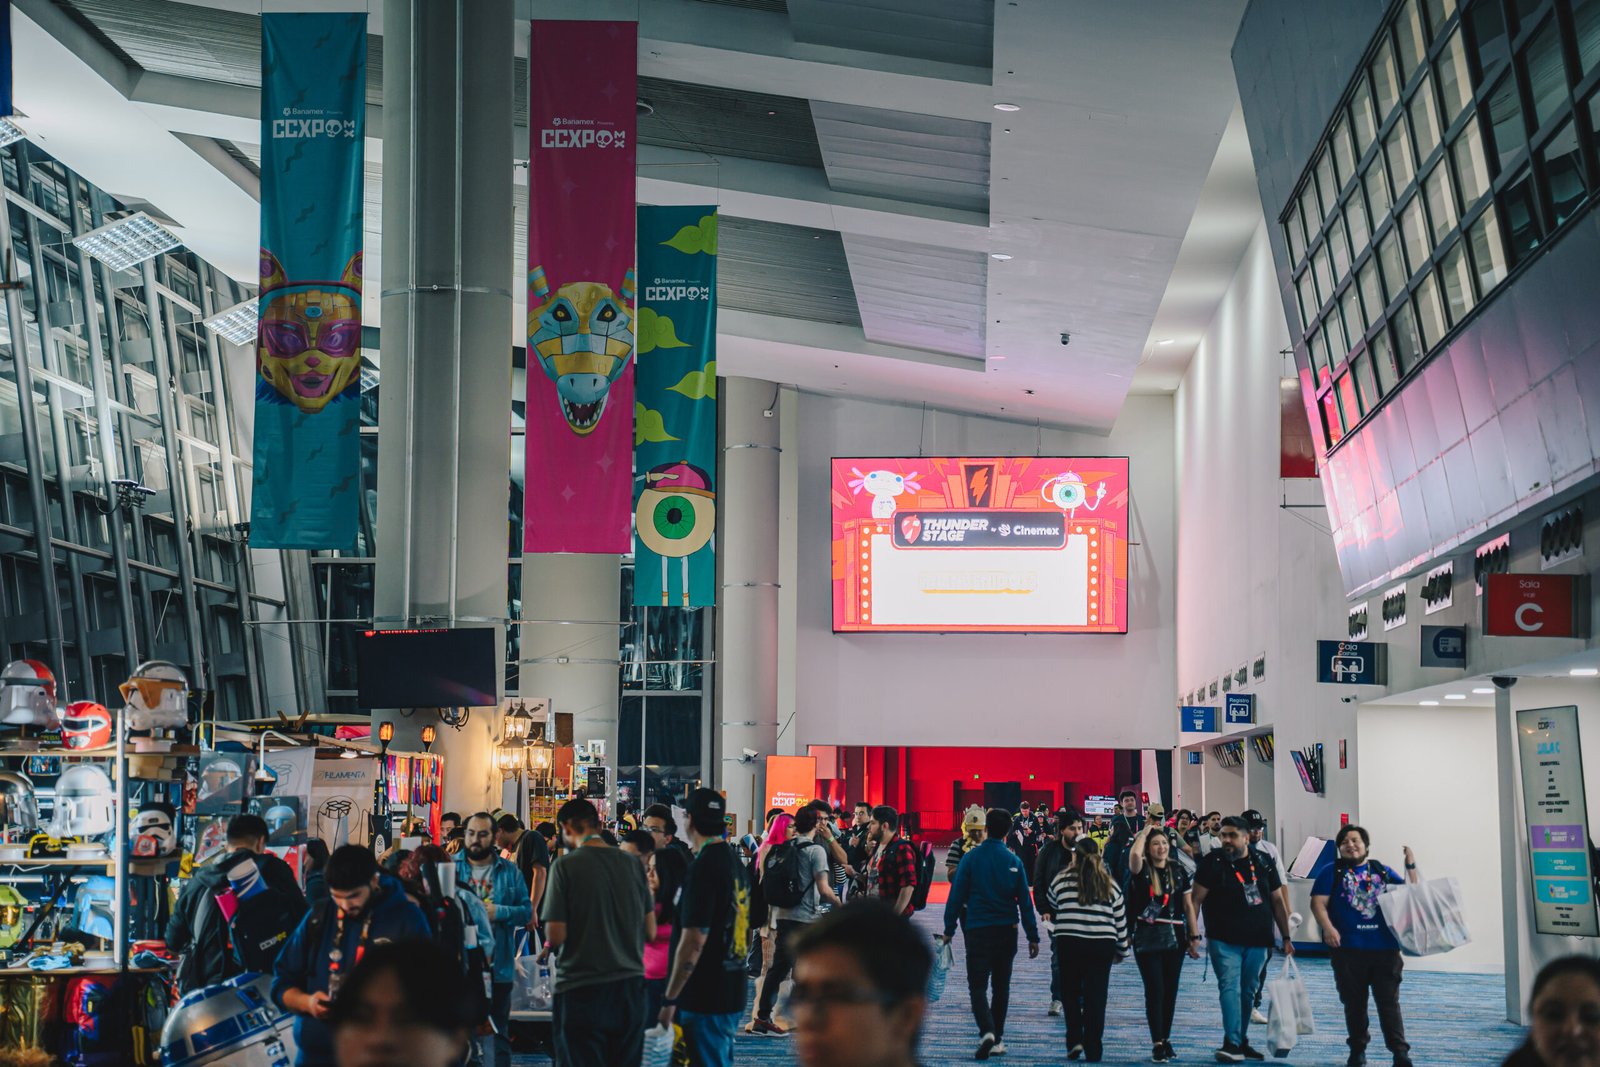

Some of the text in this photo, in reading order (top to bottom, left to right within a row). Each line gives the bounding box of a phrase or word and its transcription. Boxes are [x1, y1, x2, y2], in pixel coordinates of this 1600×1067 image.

[292, 107, 323, 115] Banamex
[922, 519, 989, 531] THUNDER
[1013, 525, 1060, 536] Cinemex
[922, 530, 965, 542] STAGE
[1519, 580, 1540, 589] Sala
[1515, 602, 1544, 632] C
[1338, 642, 1358, 652] Caja
[324, 771, 366, 779] FILAMENTA
